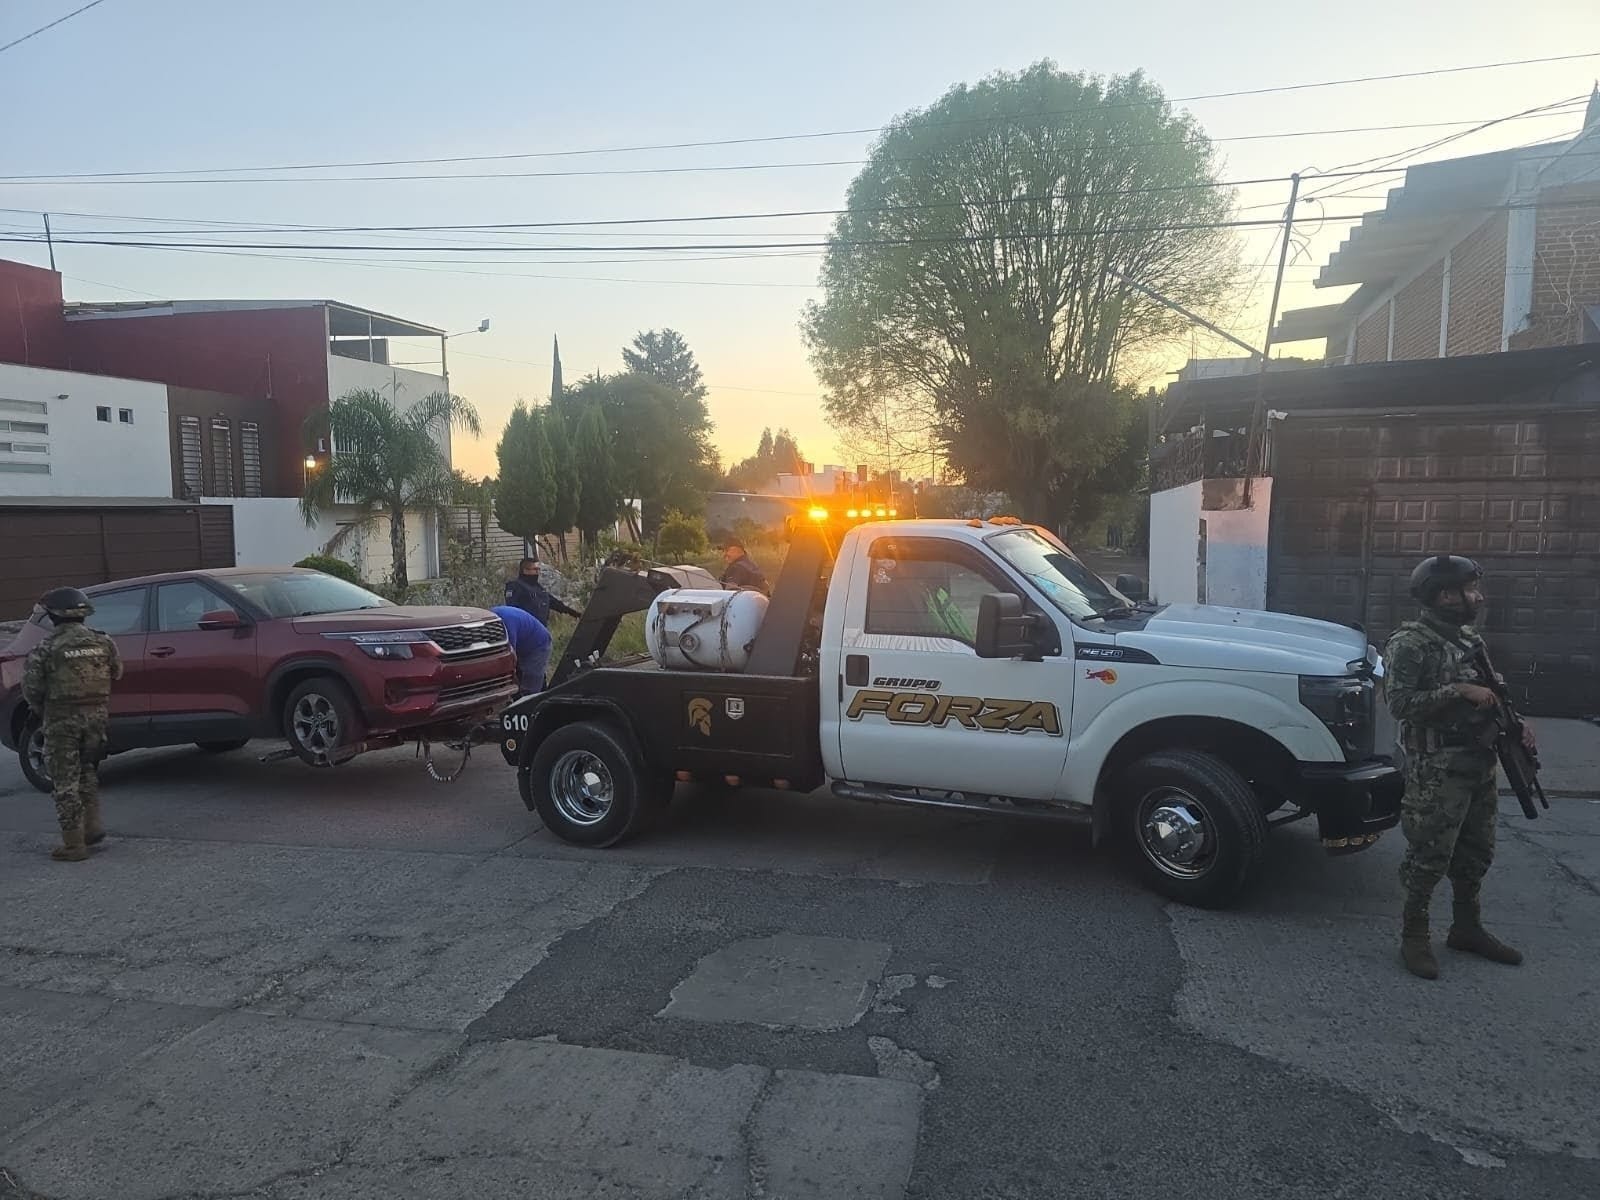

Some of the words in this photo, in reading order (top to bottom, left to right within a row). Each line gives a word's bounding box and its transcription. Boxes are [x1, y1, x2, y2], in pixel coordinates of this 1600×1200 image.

[872, 677, 942, 690] GRUPO
[846, 689, 1063, 736] FORZA
[503, 714, 529, 731] 610
